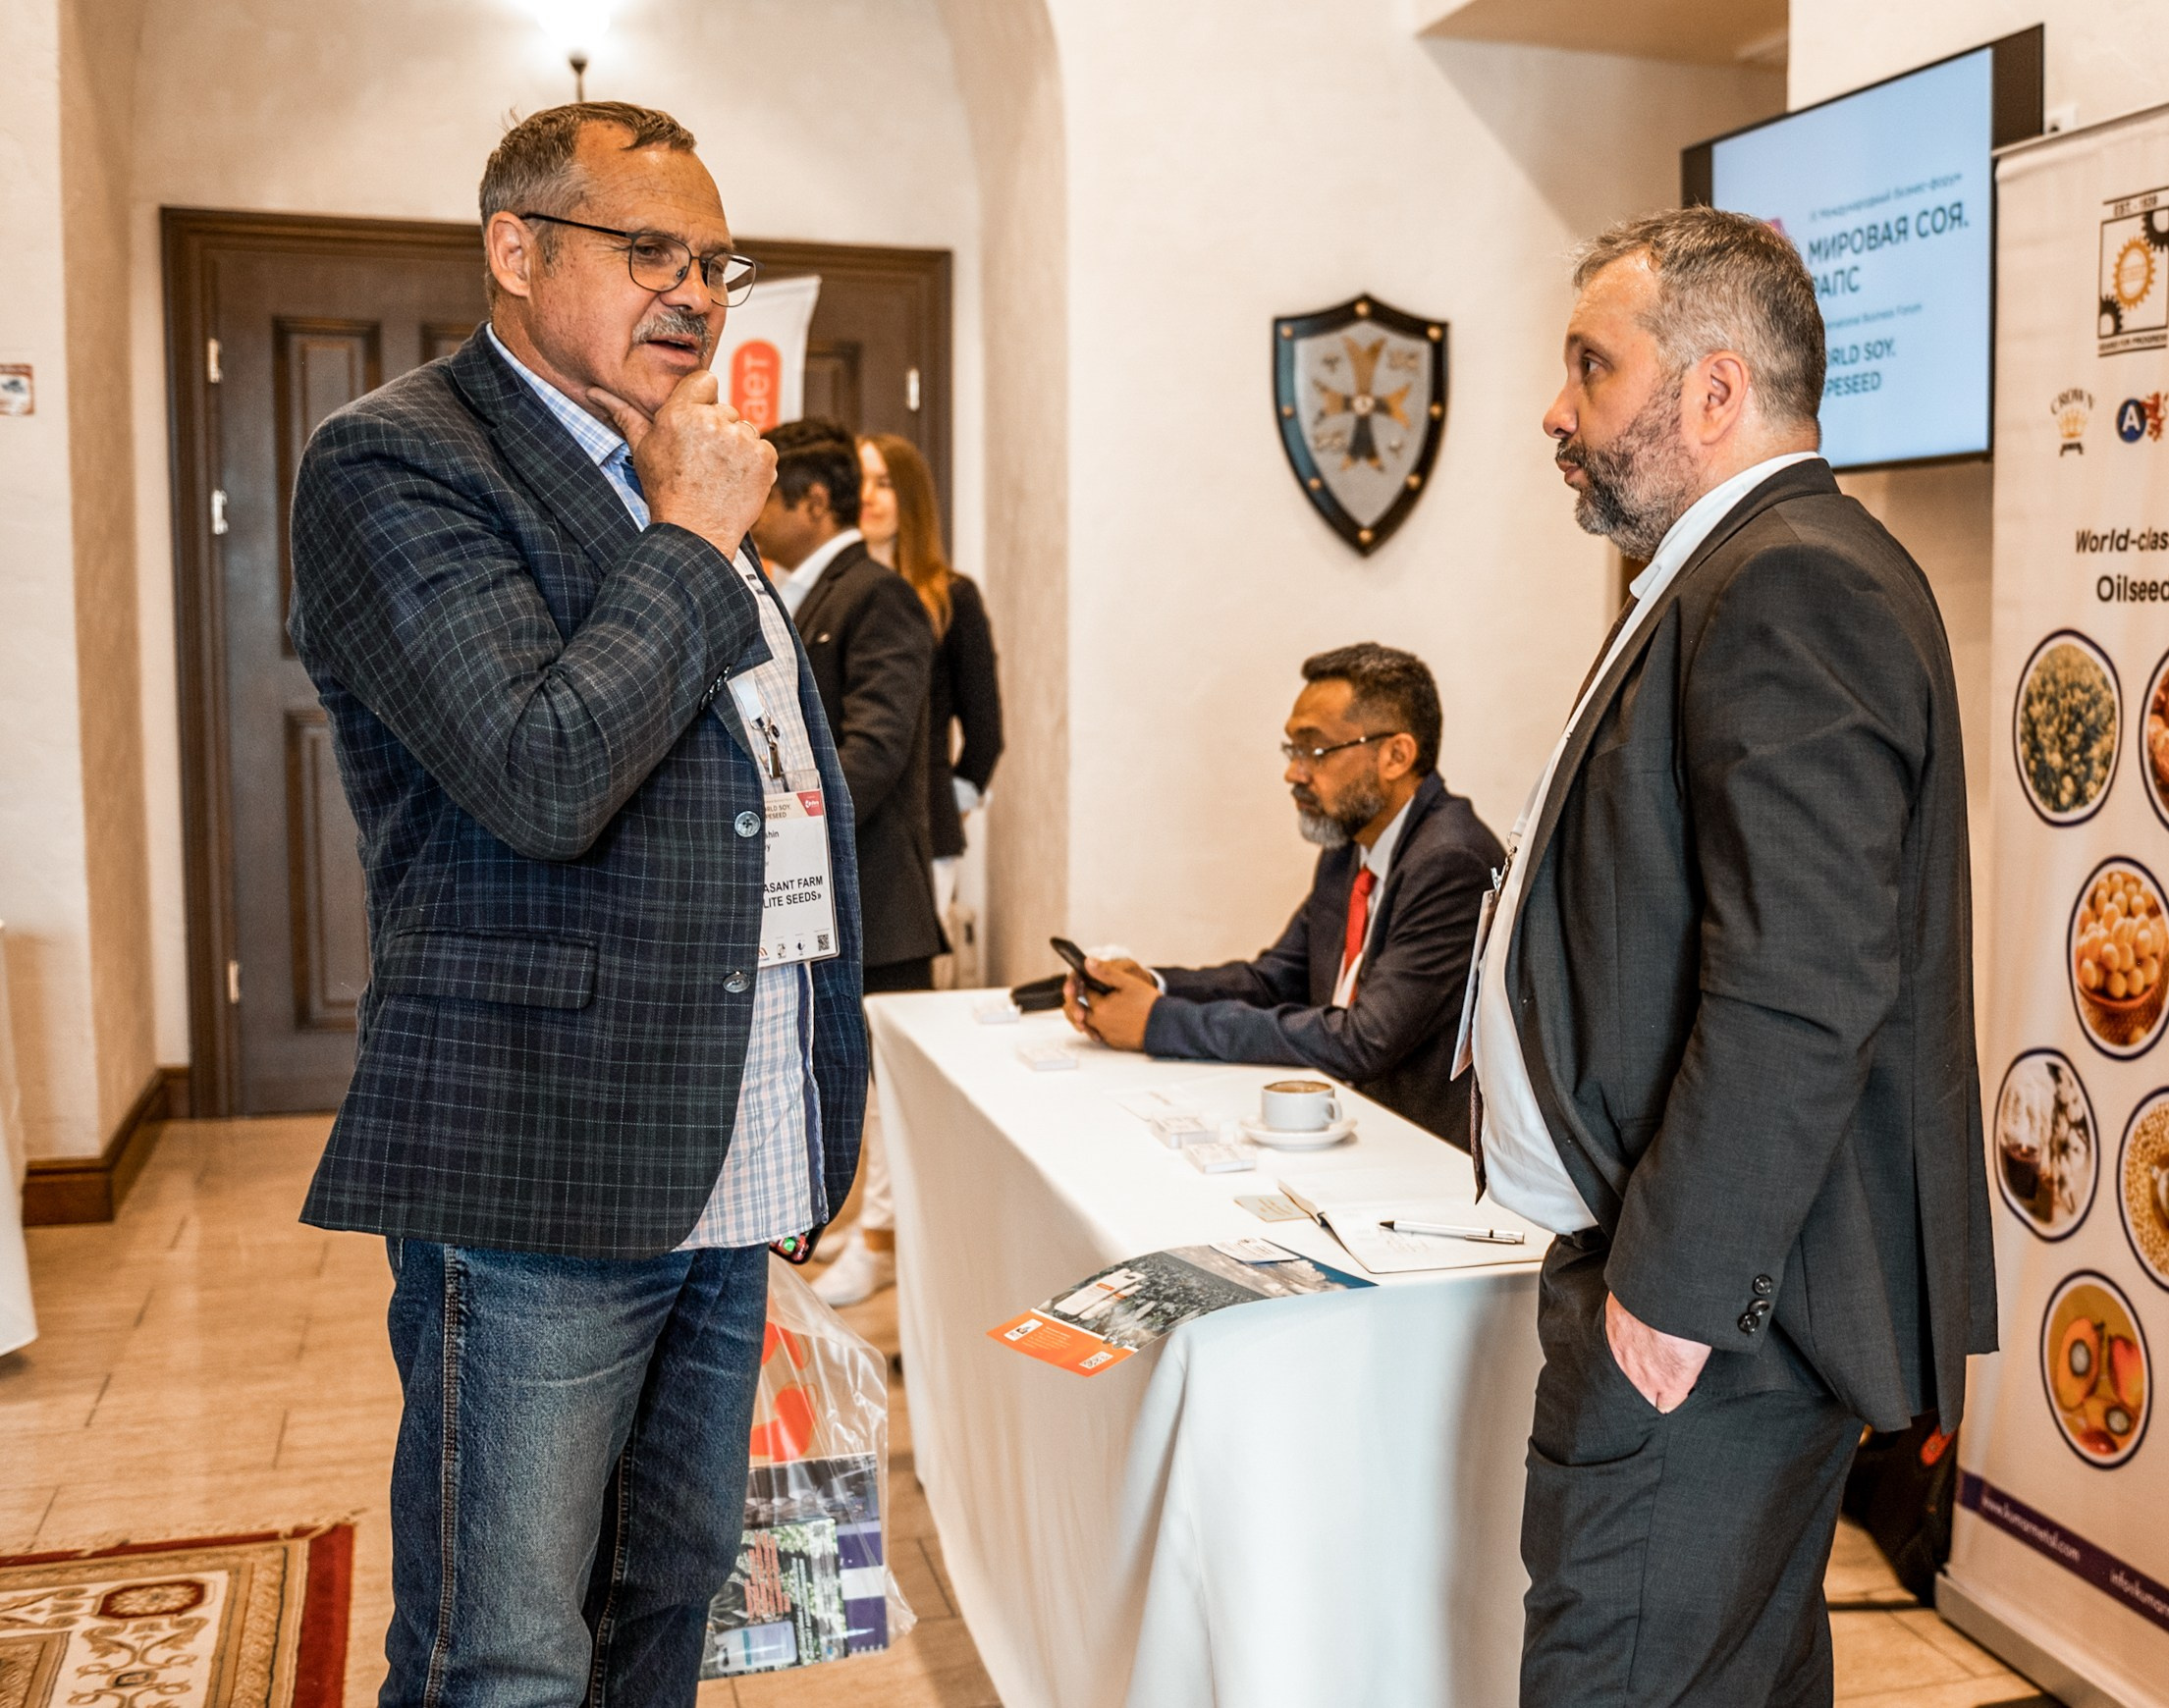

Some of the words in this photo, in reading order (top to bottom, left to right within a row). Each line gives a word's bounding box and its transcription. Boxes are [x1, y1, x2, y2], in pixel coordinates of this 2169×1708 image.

[1808, 214, 1909, 263] МИРОВАЯ
[1916, 201, 1970, 239] СОЯ.
[1826, 345, 1860, 366] RLD
[1864, 338, 1897, 361] SOY.
[763, 880, 795, 894] ASANT
[797, 876, 824, 889] FARM
[763, 896, 785, 909] LITE
